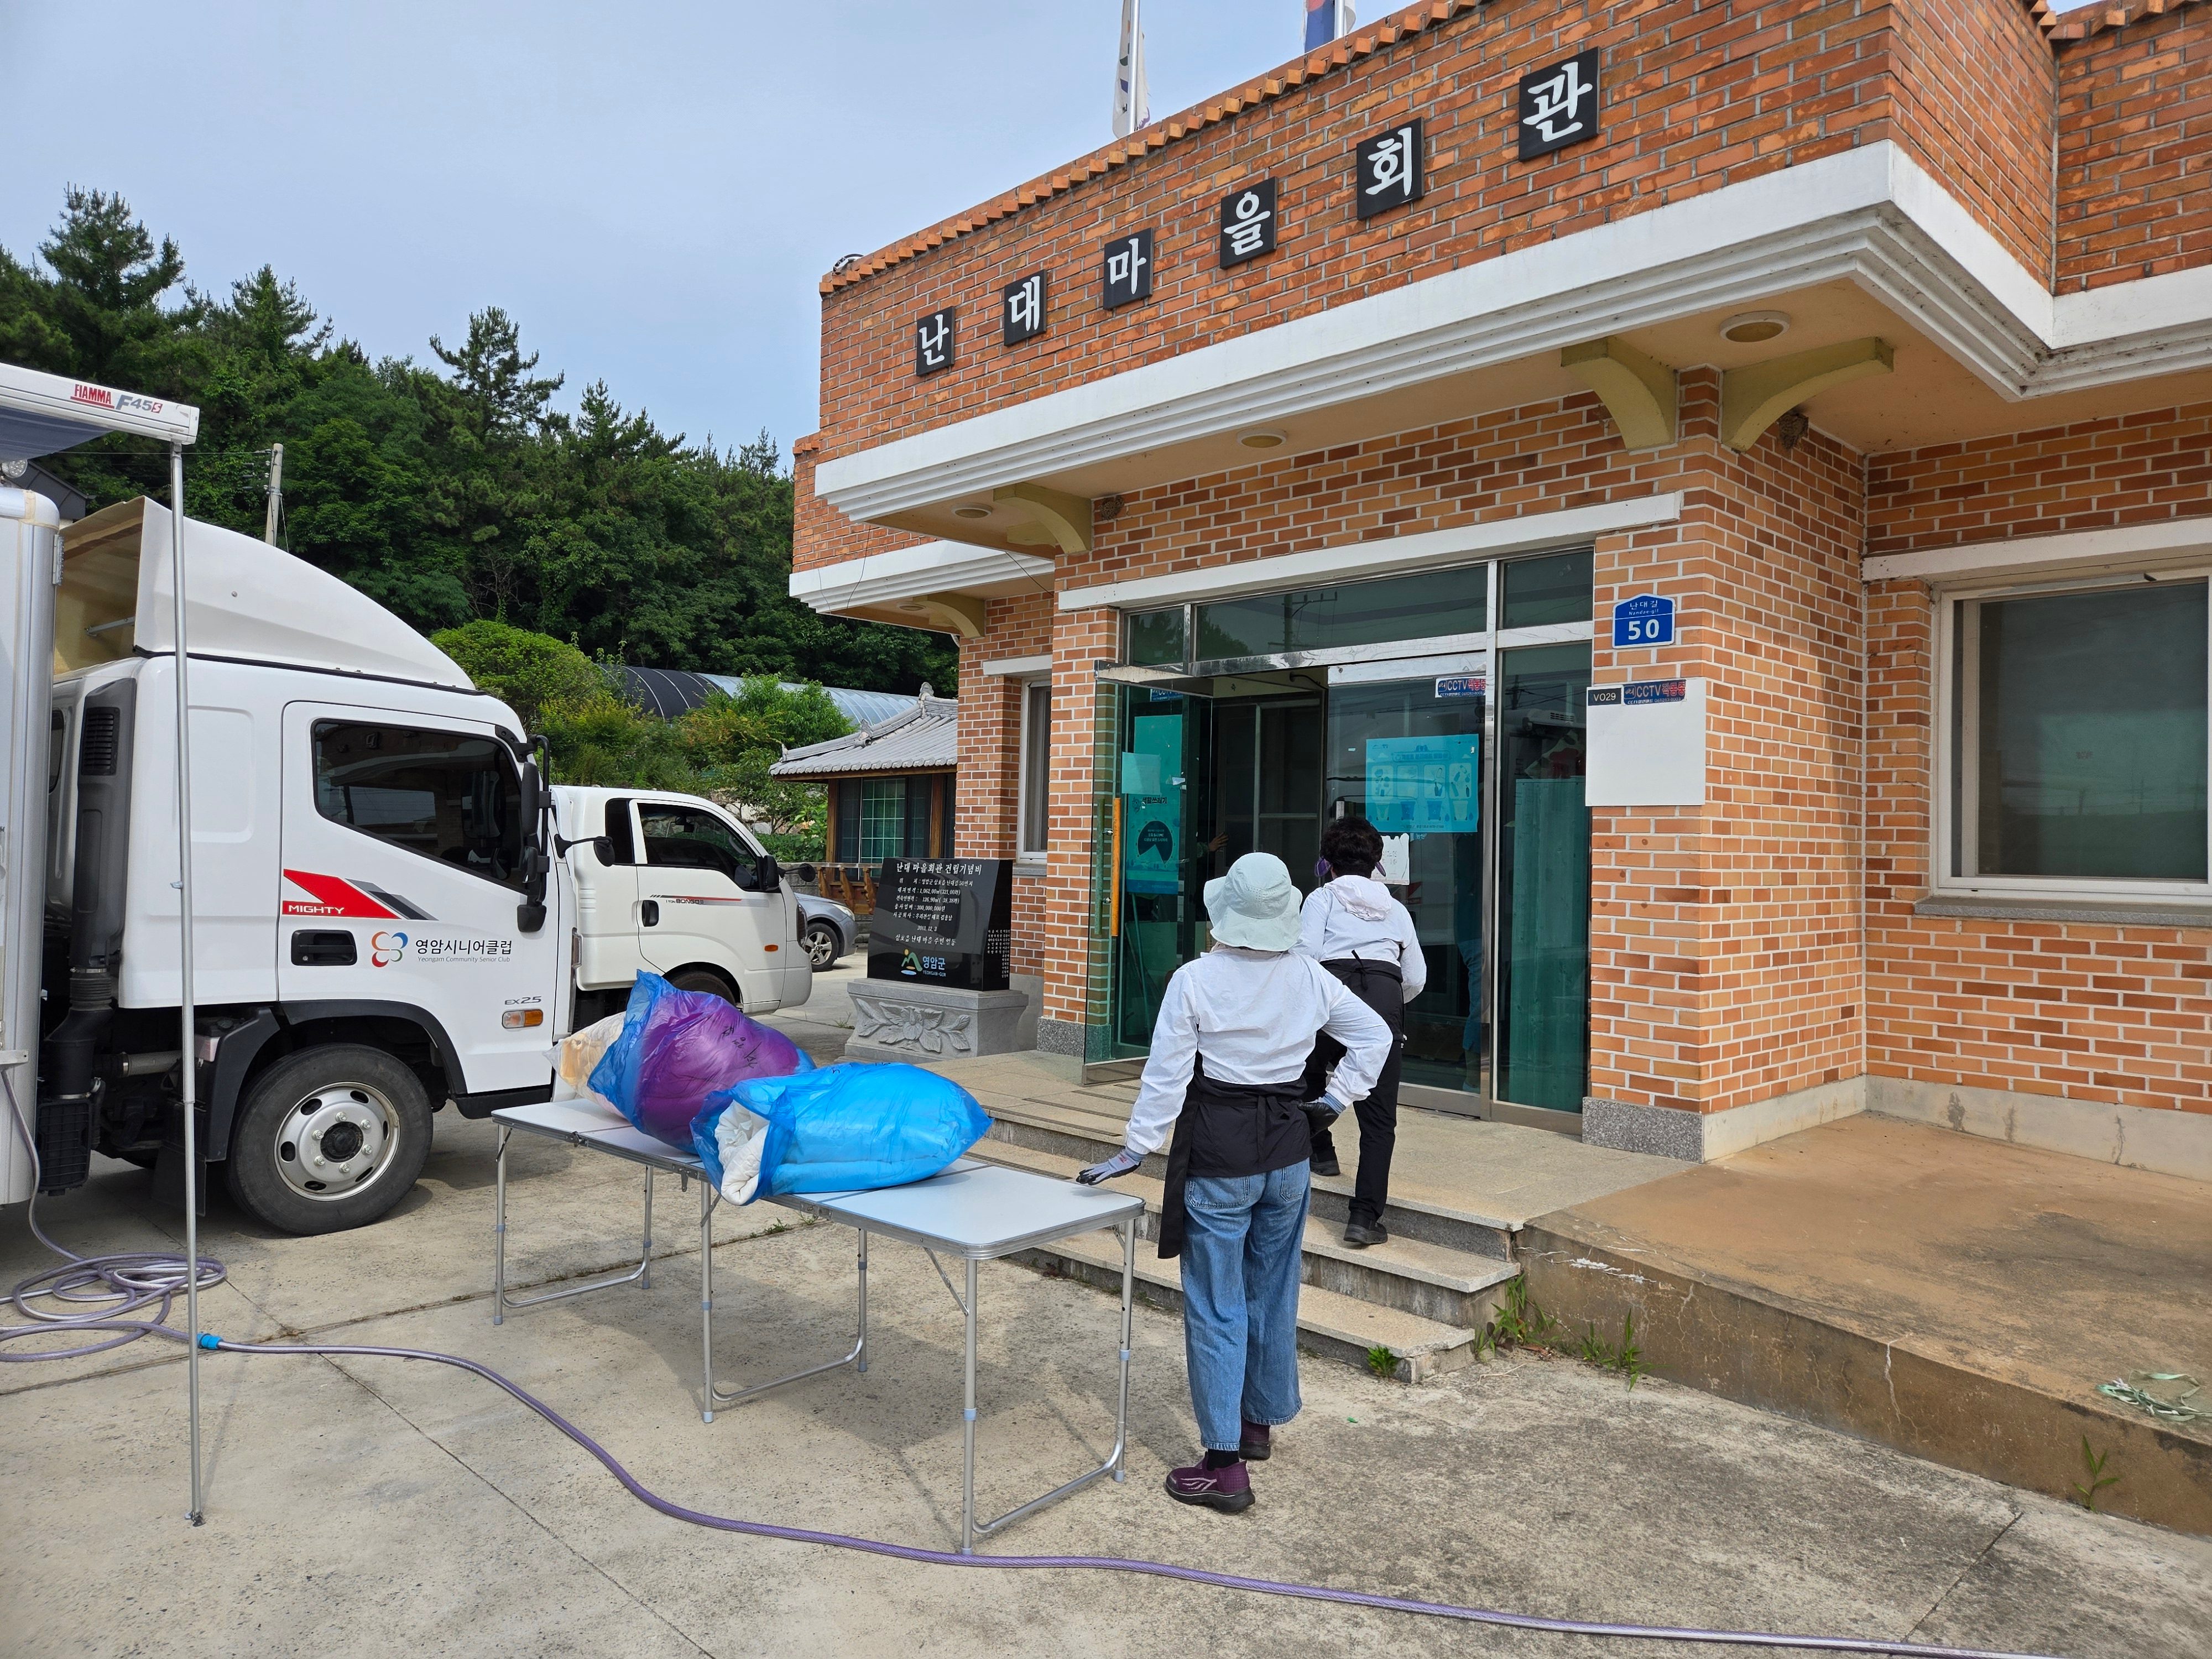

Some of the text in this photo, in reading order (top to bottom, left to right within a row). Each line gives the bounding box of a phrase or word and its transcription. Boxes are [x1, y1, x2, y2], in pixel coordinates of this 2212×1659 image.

[74, 384, 111, 404] FIAMMA
[1630, 600, 1658, 610] 난대길
[1628, 619, 1660, 640] 50
[896, 862, 982, 875] 난대 마을회관 건립기념비
[289, 905, 344, 914] MIGHTY
[415, 940, 512, 955] 영암시니어클럽
[922, 956, 946, 971] 영암군
[504, 996, 542, 1005] EX25
